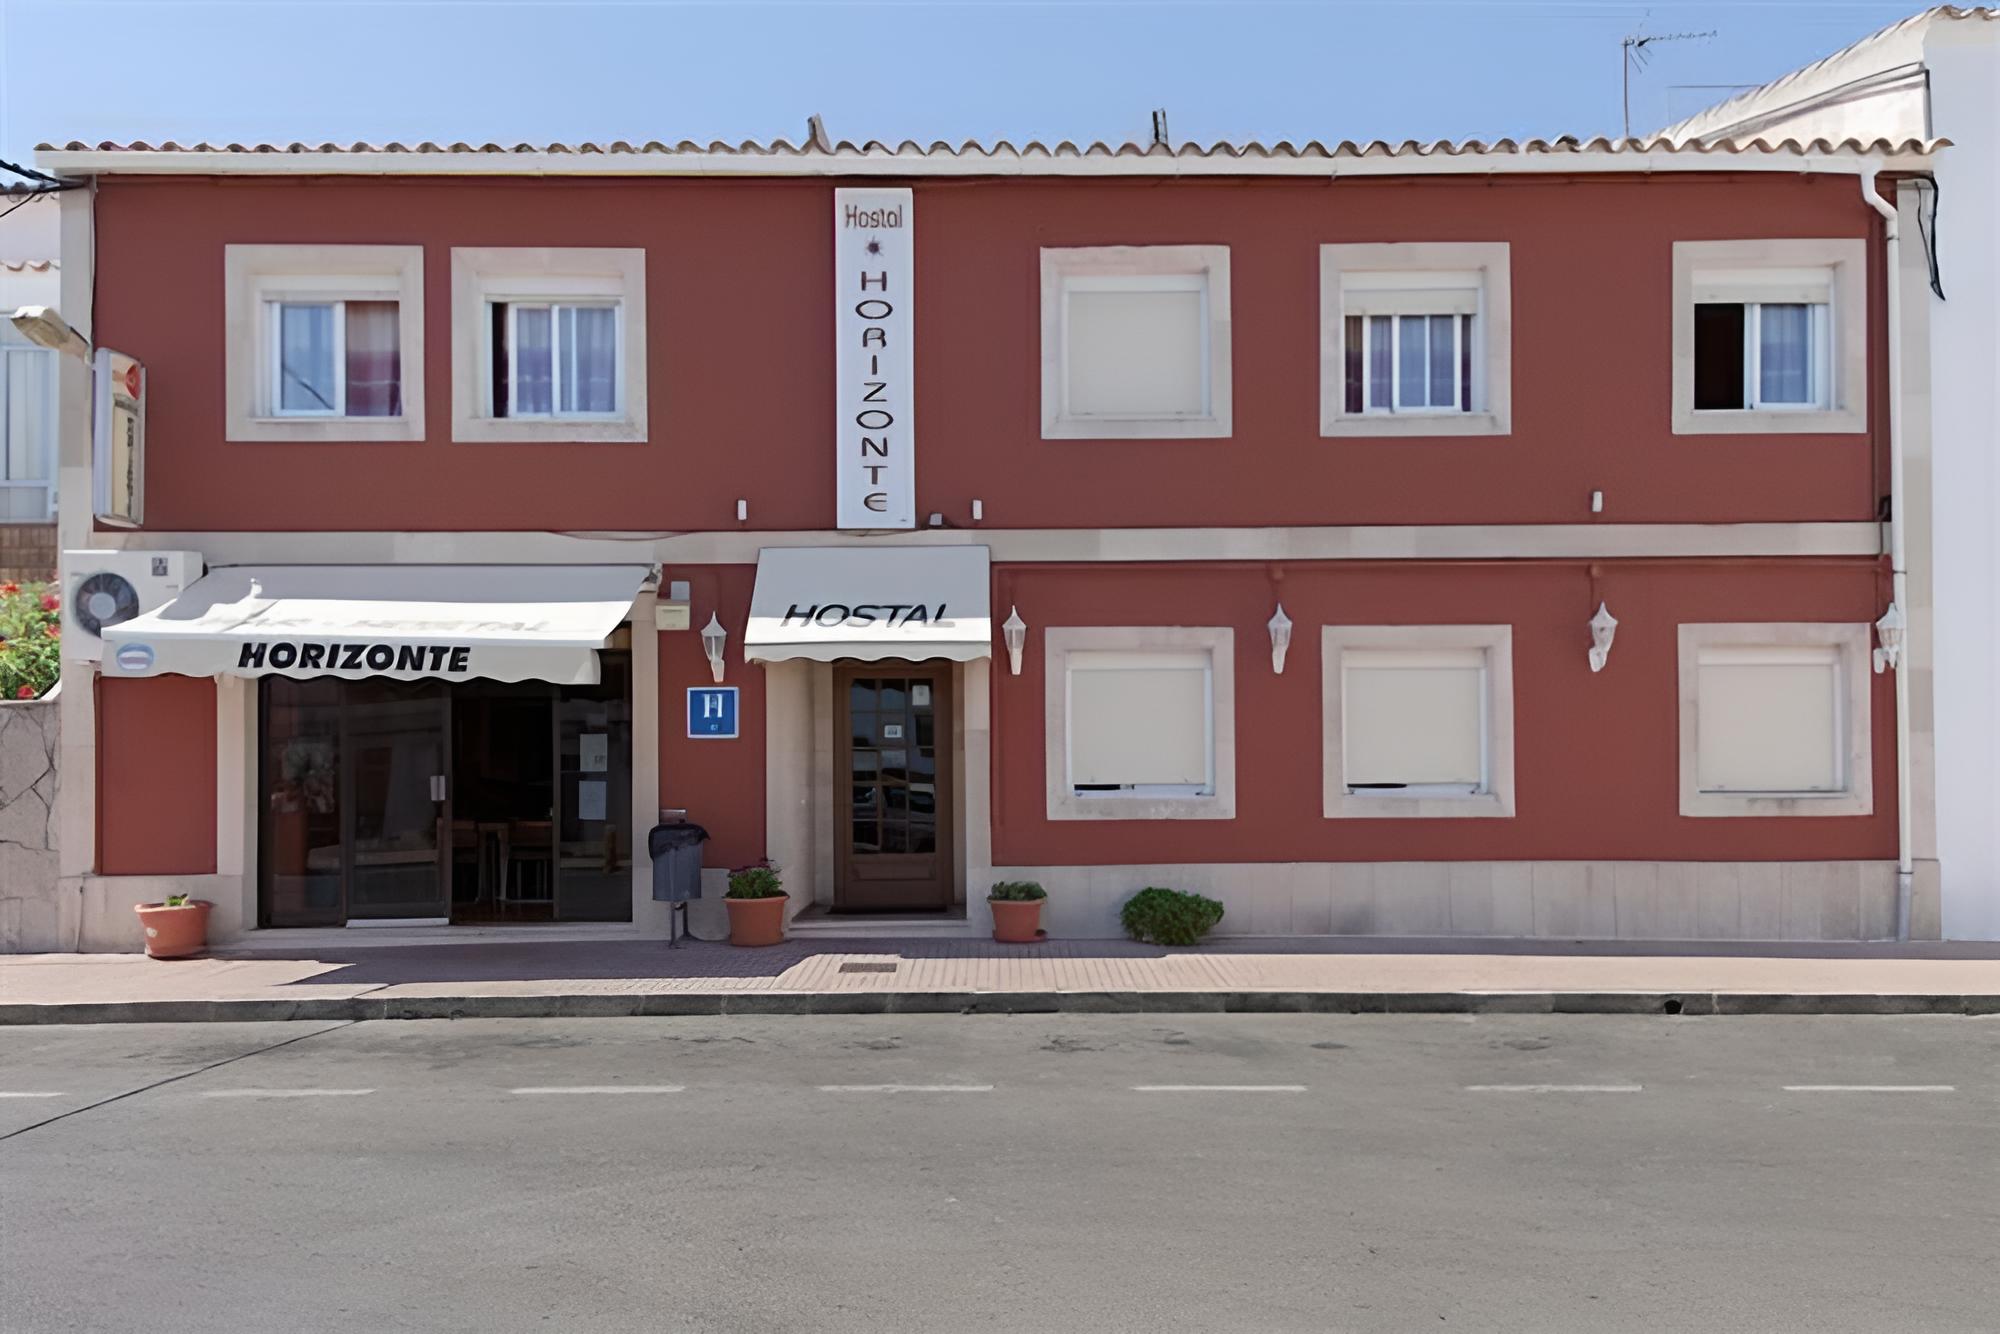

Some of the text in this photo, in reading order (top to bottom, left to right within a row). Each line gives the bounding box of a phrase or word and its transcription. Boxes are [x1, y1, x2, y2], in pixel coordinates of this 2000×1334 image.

[845, 204, 903, 229] Hostal
[855, 271, 894, 512] HORIZONTE
[779, 603, 956, 628] HOSTAL
[237, 642, 471, 672] HORIZONTE
